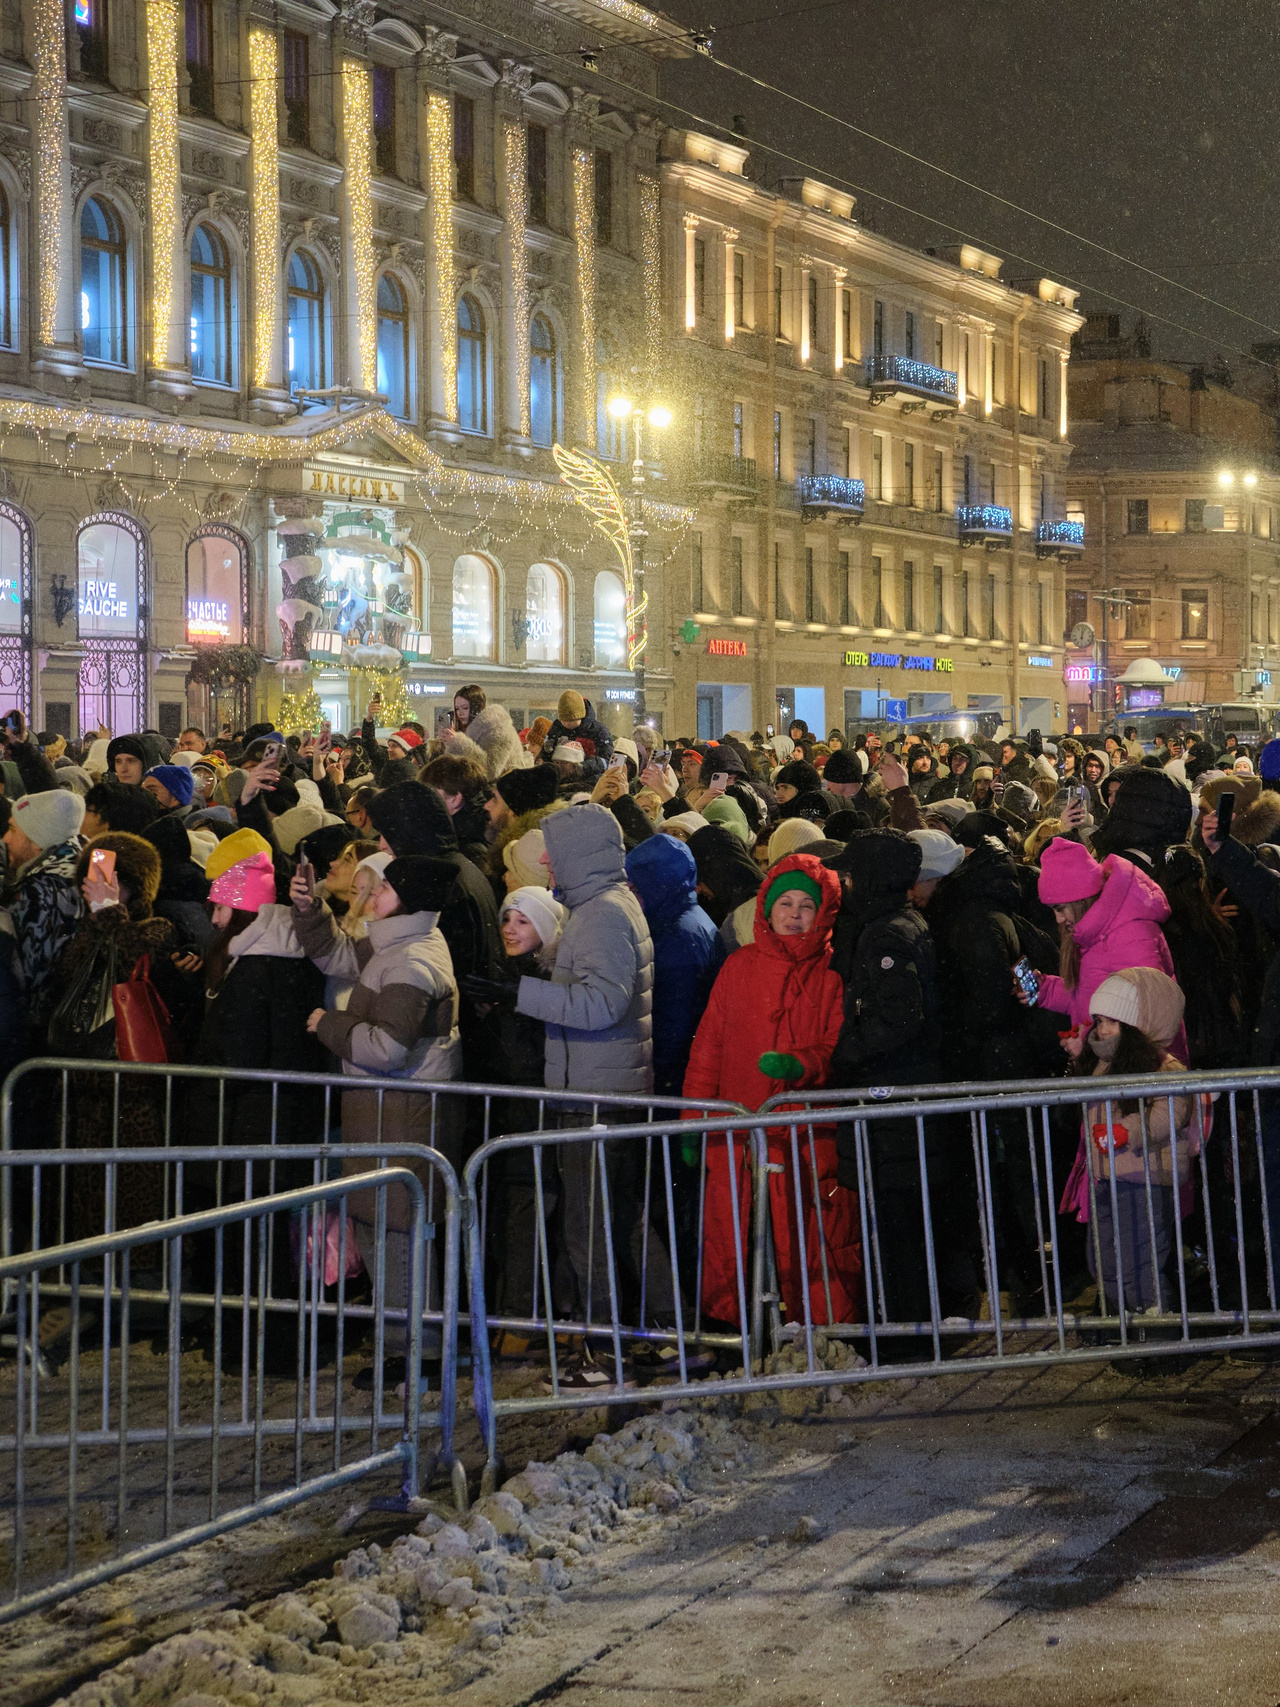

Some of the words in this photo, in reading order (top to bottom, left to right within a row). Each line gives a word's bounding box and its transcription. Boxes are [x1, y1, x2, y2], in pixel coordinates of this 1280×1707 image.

[310, 471, 399, 501] ПАССАЖЪ
[87, 580, 117, 598] RIVE
[78, 599, 127, 617] GAUCHE
[709, 639, 747, 656] АПТЕКА
[845, 651, 868, 666] ОТЕЛЬ
[936, 658, 955, 672] HOTEL
